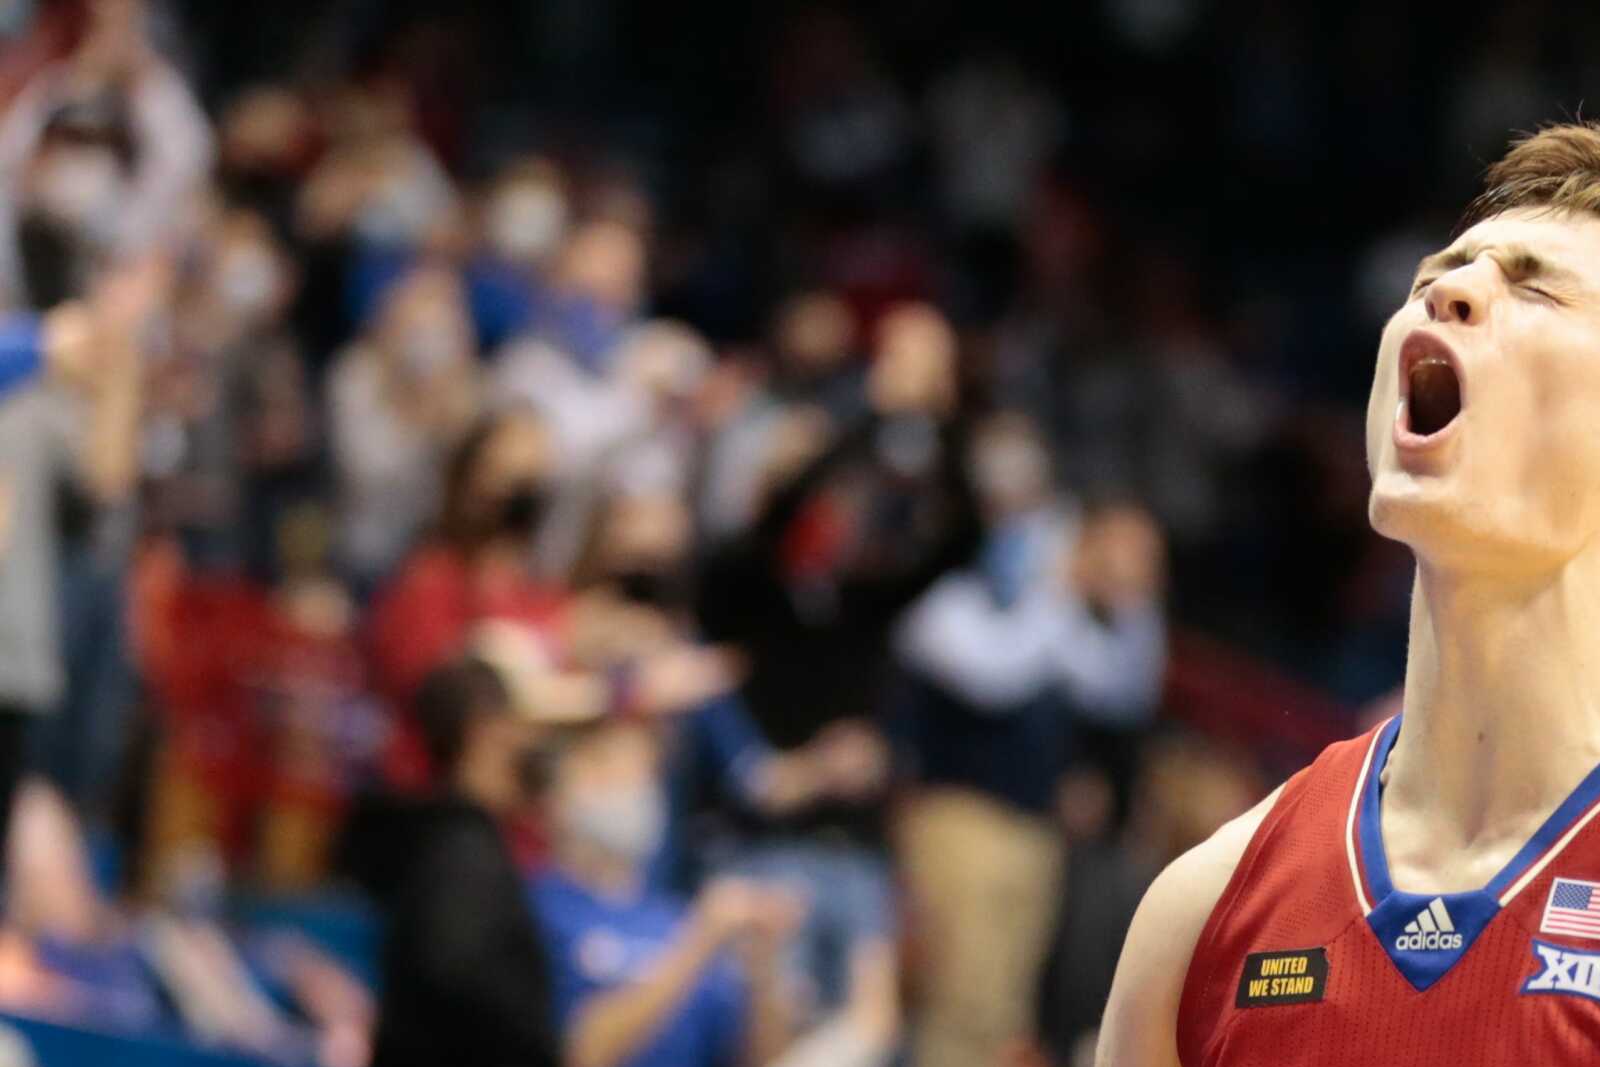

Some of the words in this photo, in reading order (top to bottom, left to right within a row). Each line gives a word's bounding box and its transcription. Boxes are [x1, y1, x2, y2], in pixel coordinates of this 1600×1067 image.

[1395, 931, 1463, 951] adidas
[1260, 956, 1308, 977] UNITED
[1248, 979, 1270, 998] WE
[1270, 976, 1314, 996] STAND
